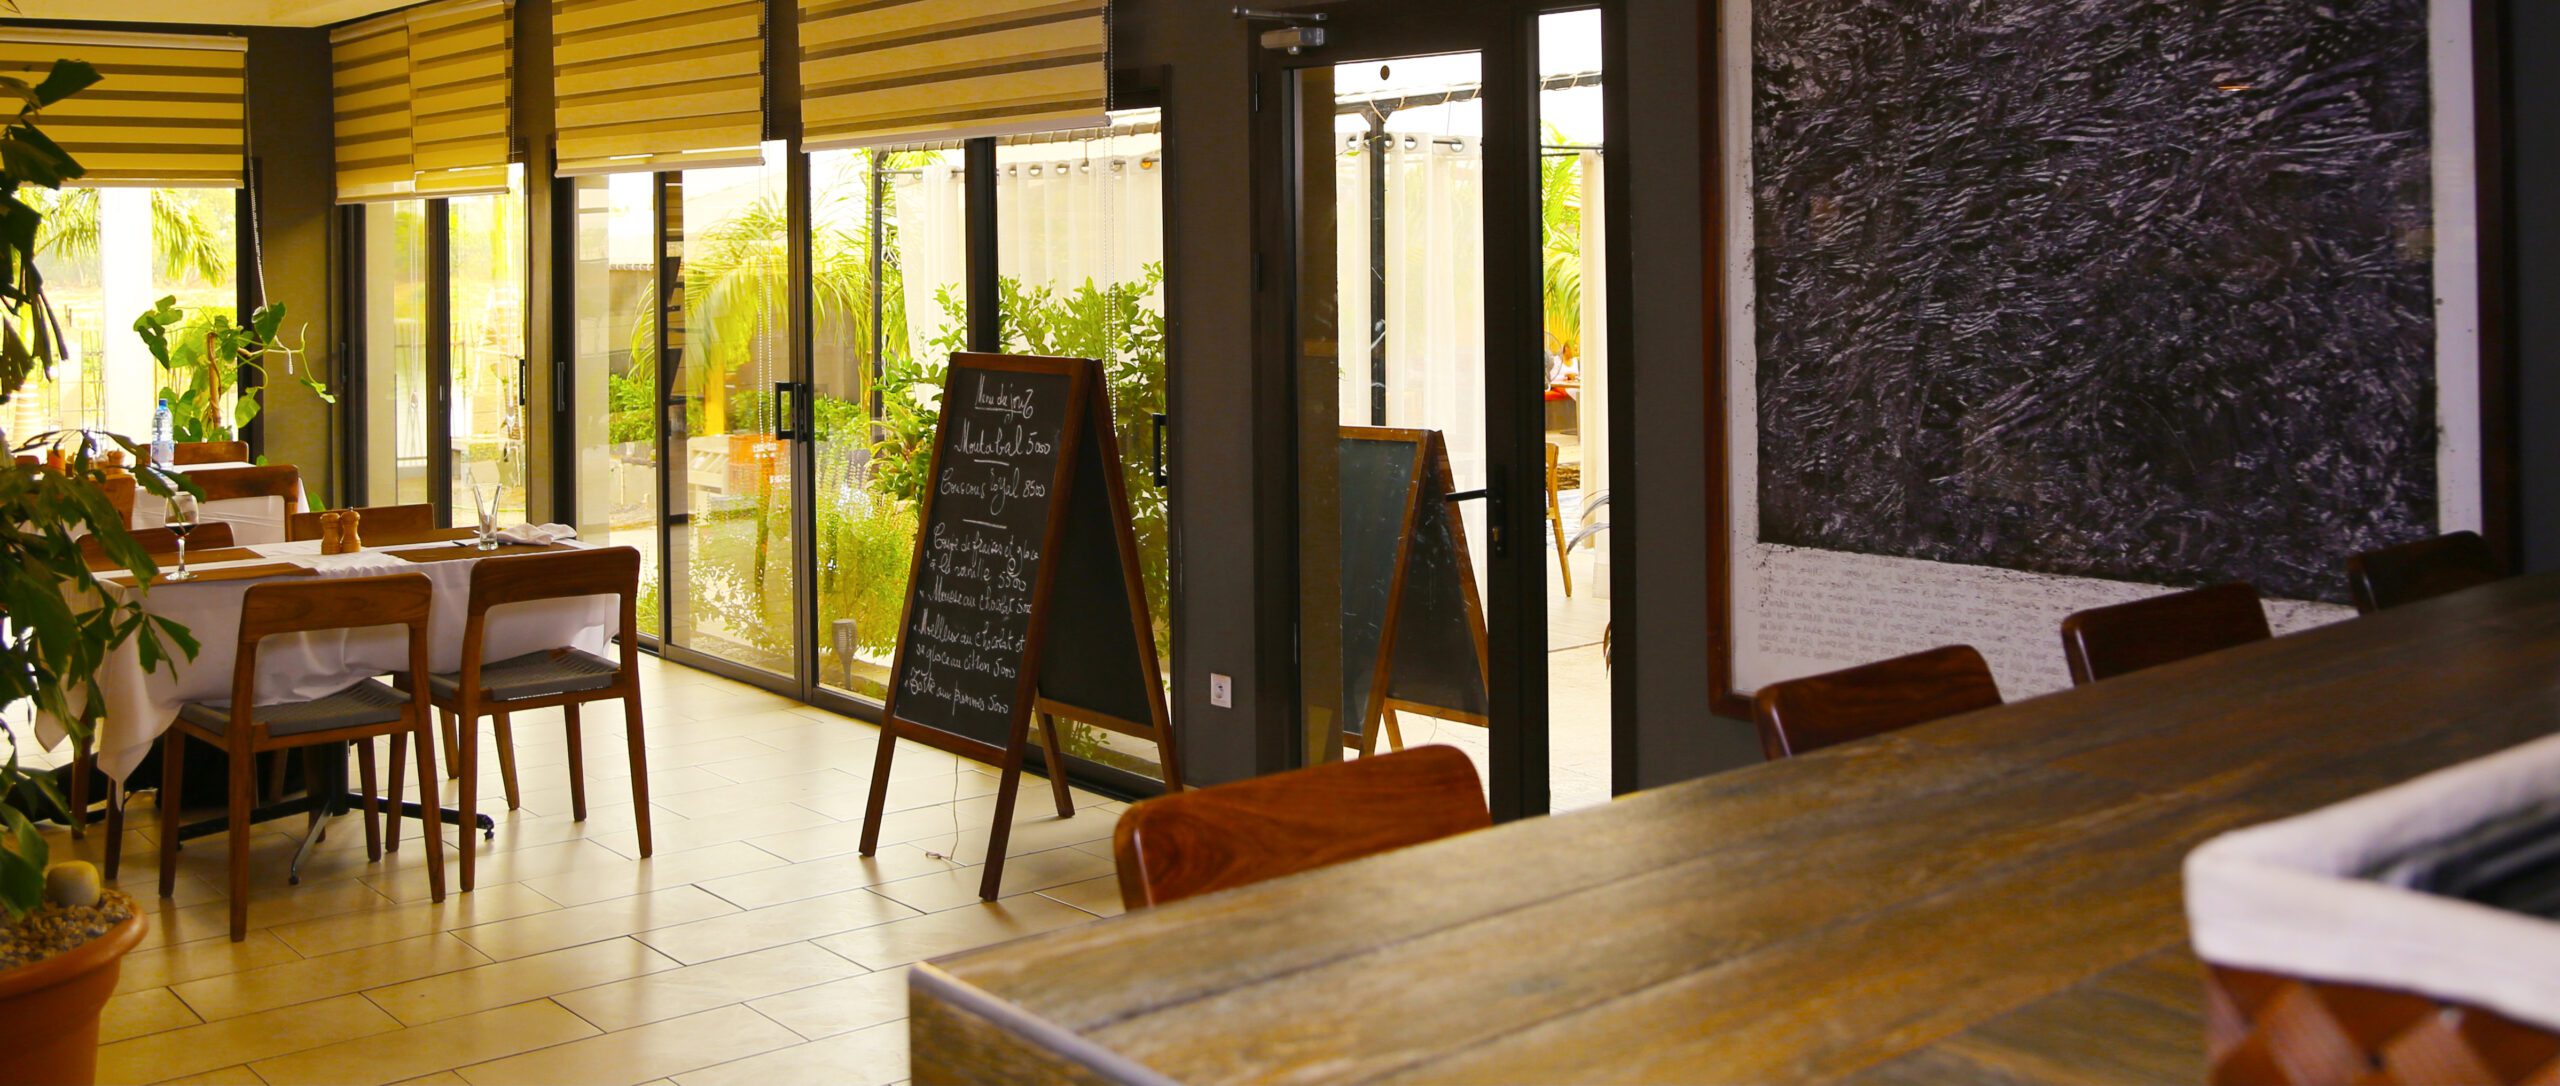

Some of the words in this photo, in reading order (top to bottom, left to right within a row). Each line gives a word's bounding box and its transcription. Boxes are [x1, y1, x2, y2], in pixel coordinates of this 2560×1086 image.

[975, 373, 994, 406] Menu
[1025, 431, 1051, 455] 5000
[940, 467, 986, 499] Couscous
[1022, 480, 1046, 498] 8500
[960, 633, 973, 646] au
[1015, 634, 1026, 652] et
